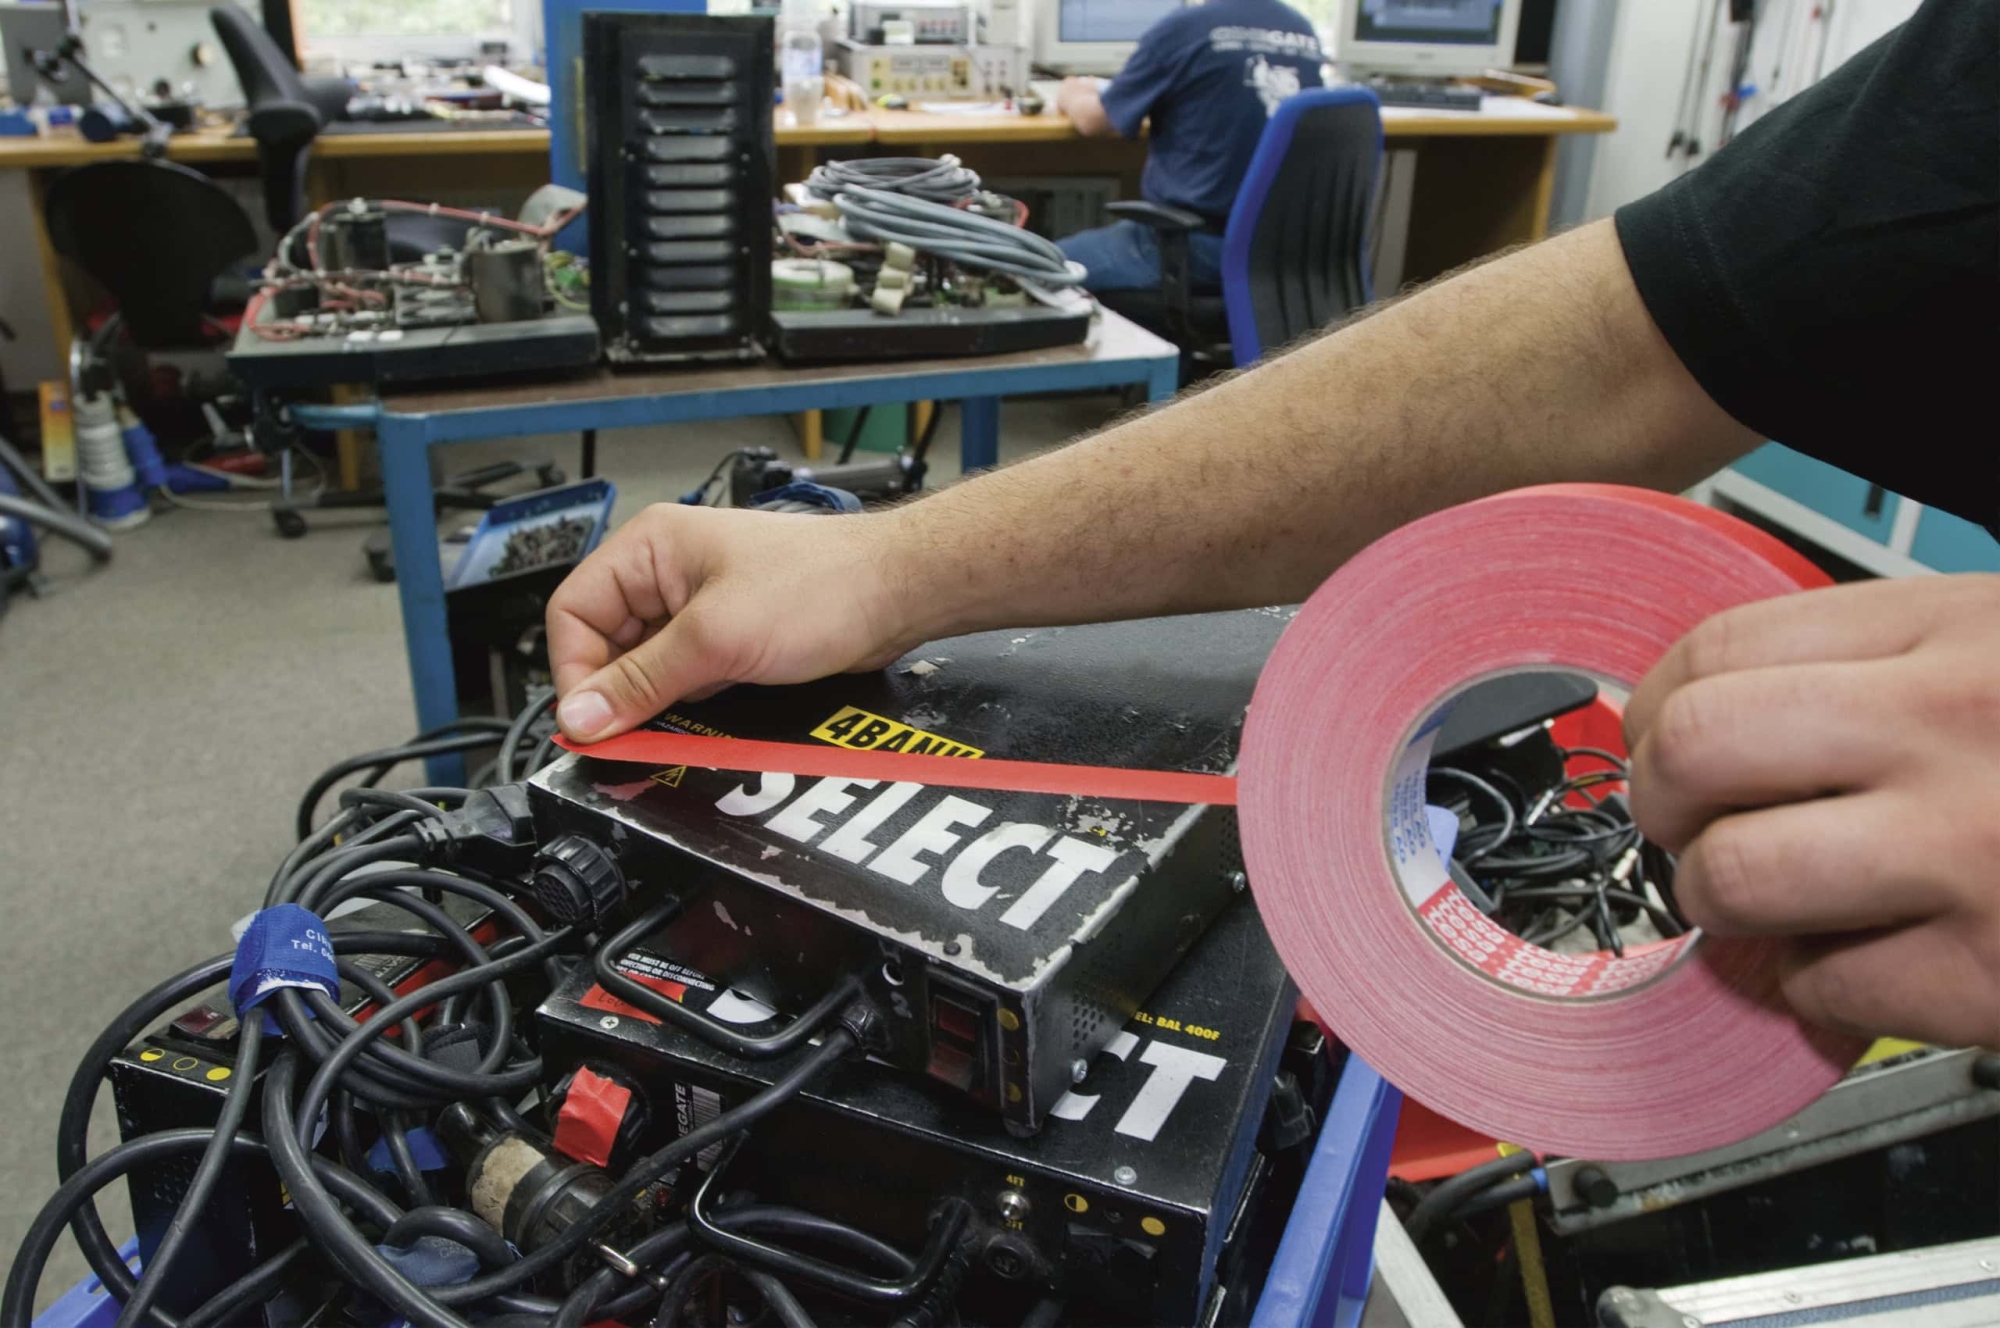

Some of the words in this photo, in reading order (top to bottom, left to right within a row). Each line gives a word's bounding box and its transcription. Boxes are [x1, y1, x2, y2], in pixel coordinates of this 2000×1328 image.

[664, 713, 737, 739] WARNI
[1428, 905, 1489, 963] tesa
[1437, 898, 1497, 954] tesa
[291, 939, 318, 953] Tel.
[1156, 1016, 1181, 1032] BAL
